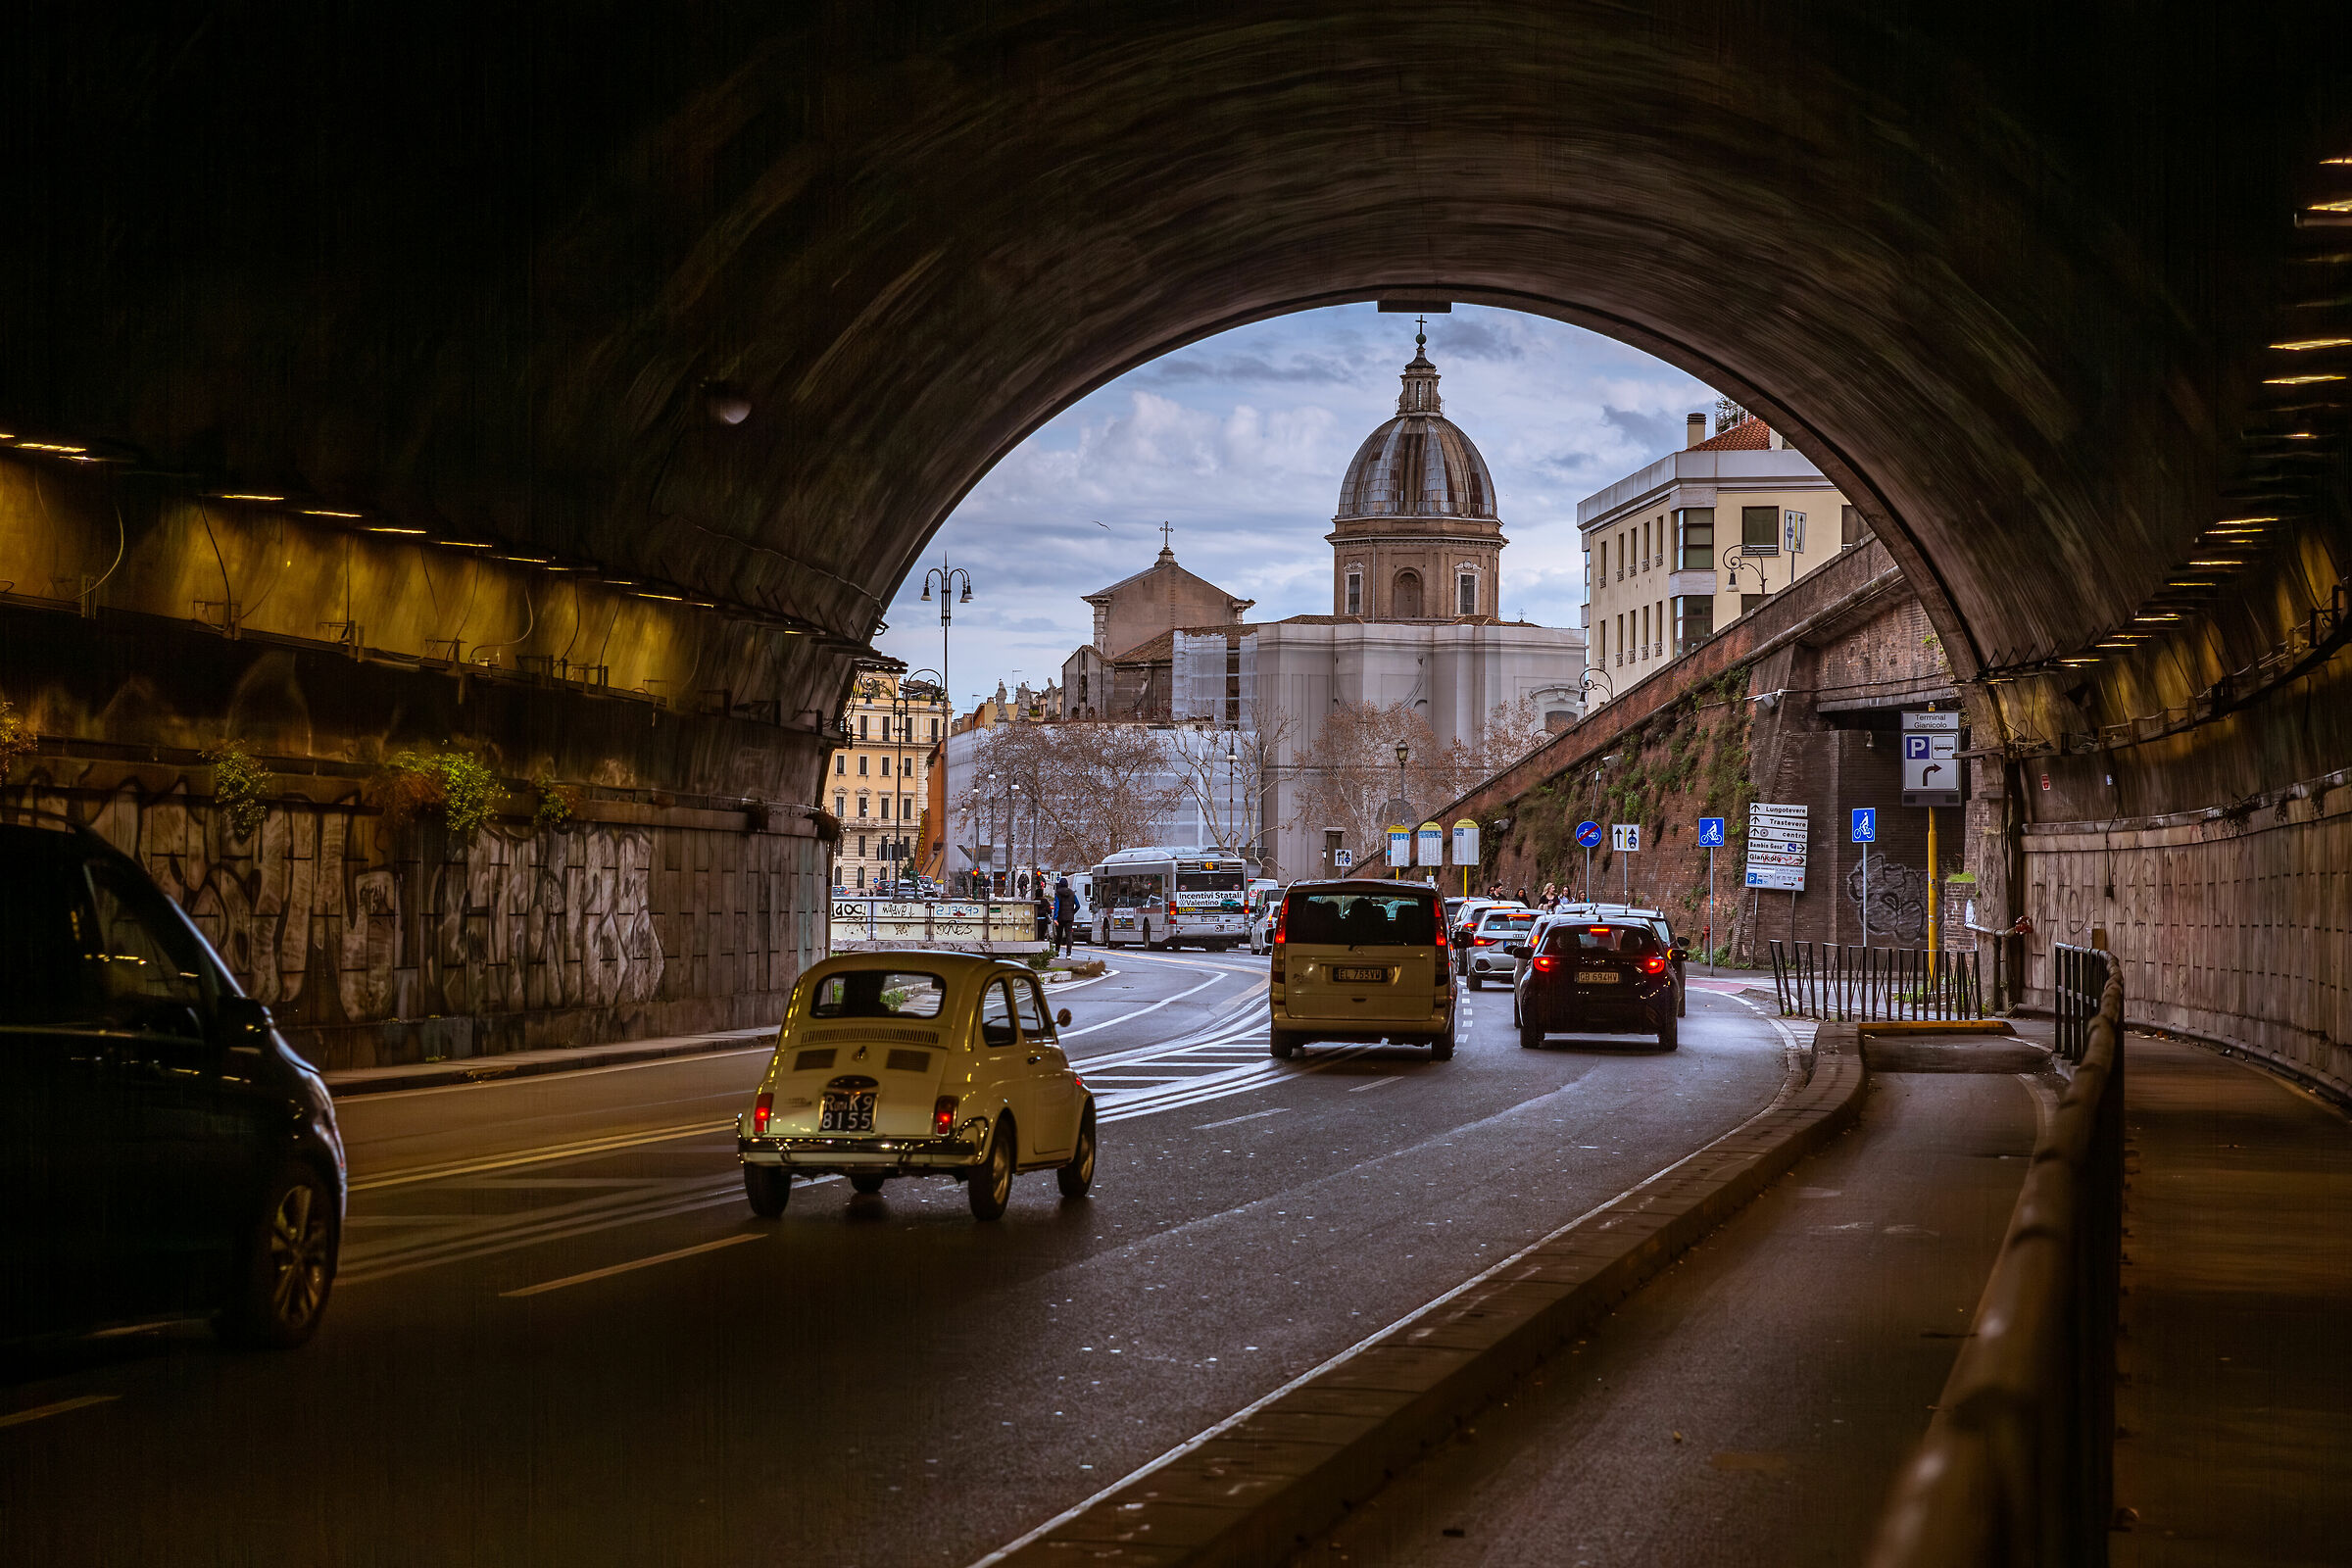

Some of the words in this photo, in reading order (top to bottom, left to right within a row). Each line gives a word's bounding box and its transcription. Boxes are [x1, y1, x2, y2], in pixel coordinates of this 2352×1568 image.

[1765, 806, 1806, 814] Lungotevere
[1769, 818, 1806, 828] Trastevere
[1215, 891, 1242, 900] Statali
[822, 1111, 871, 1129] 8155
